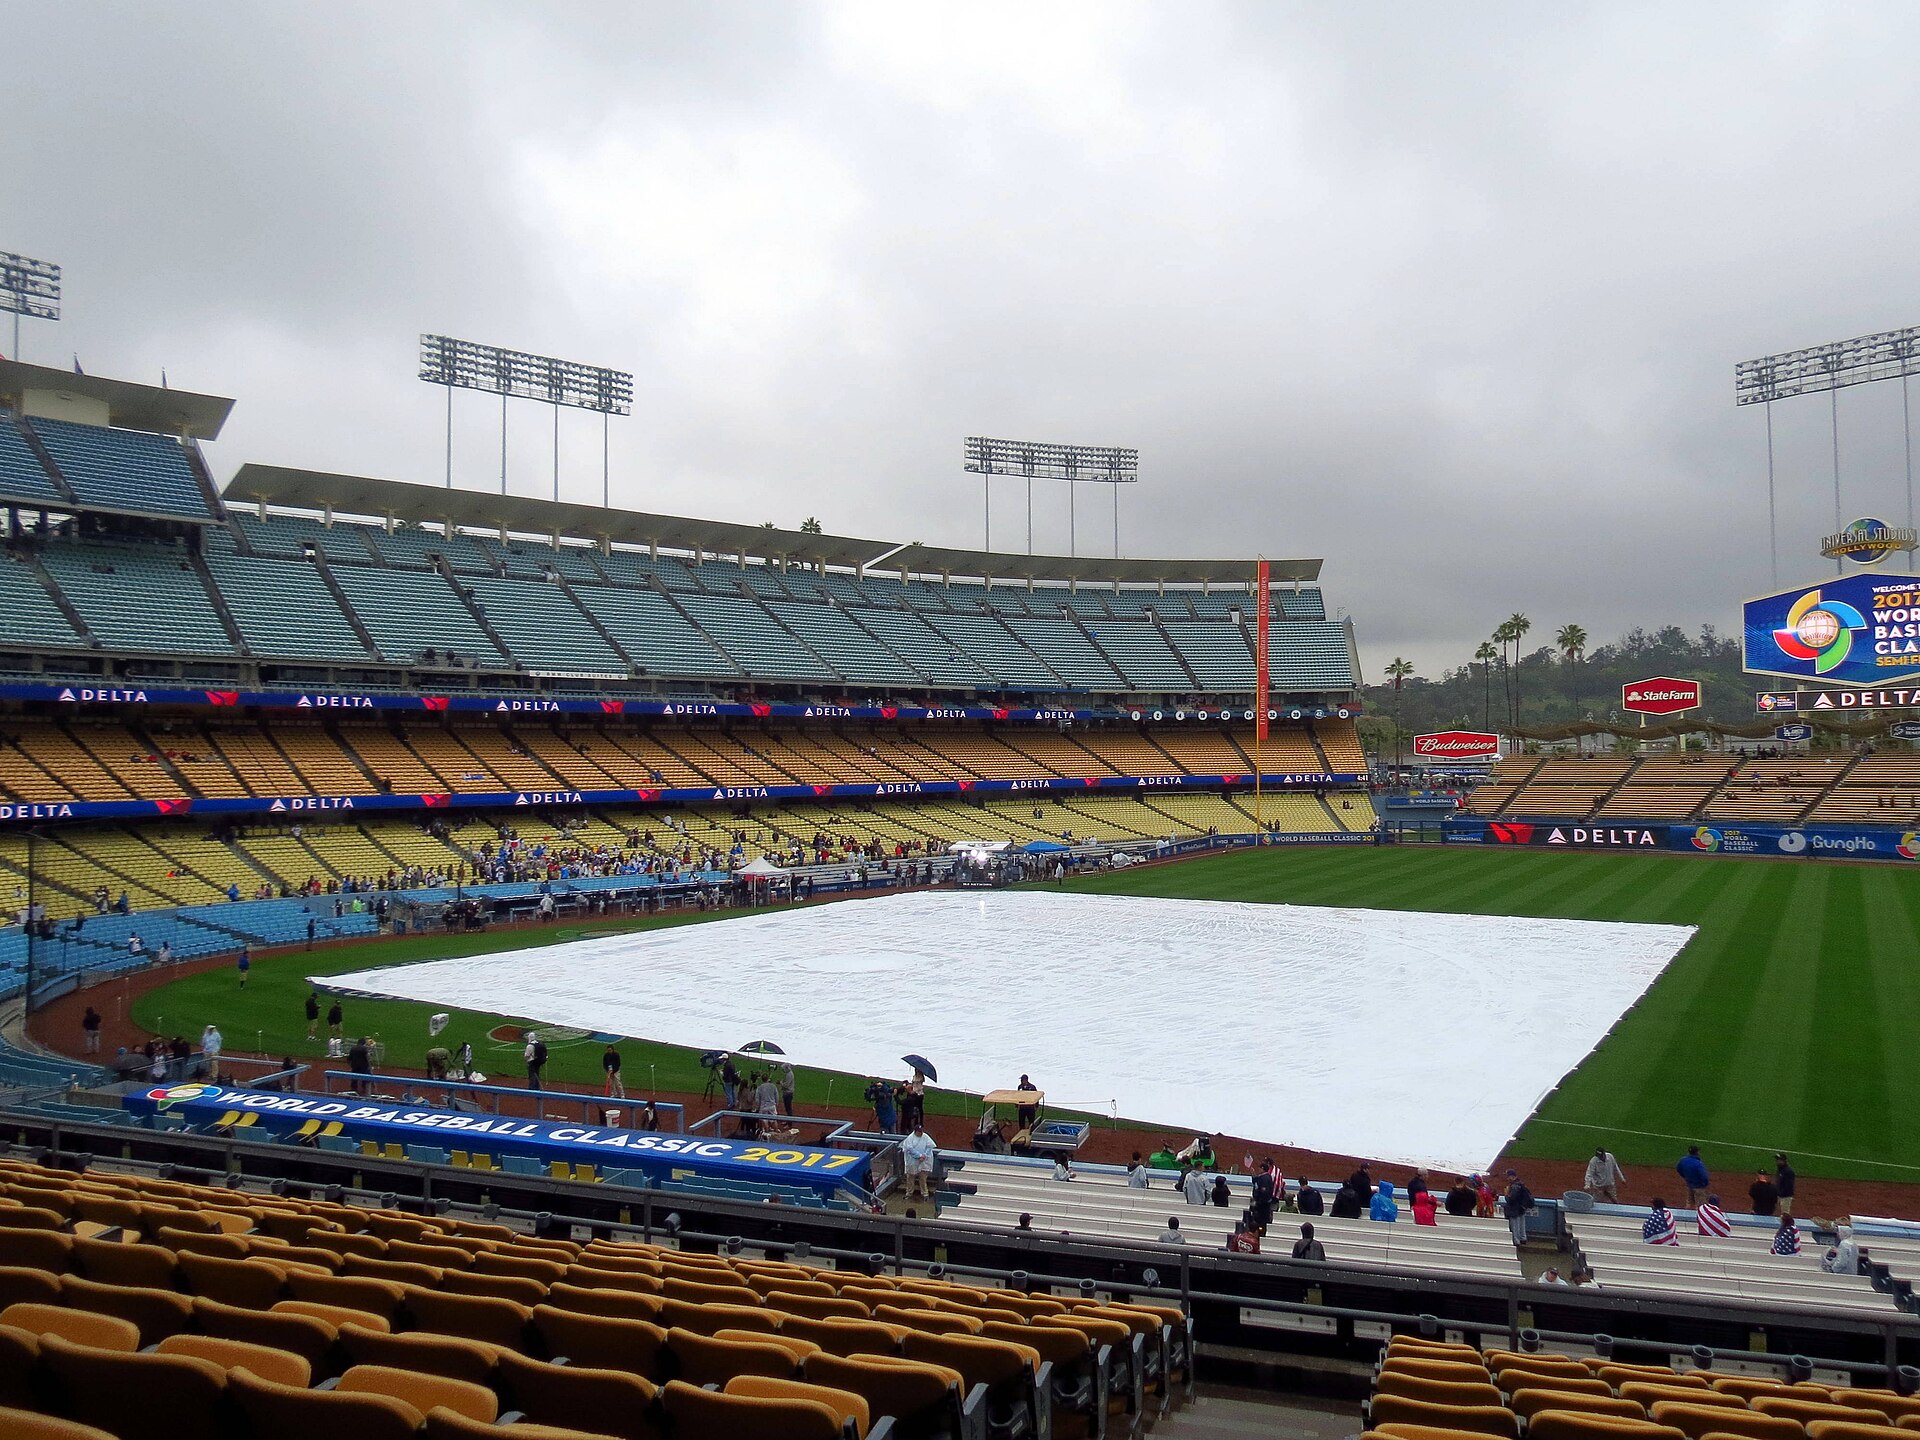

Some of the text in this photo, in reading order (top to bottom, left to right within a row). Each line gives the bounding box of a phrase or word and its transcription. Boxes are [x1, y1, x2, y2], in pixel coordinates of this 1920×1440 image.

[1820, 527, 1914, 550] UNIVERSAL STUDIOS
[1832, 542, 1902, 556] HOLLYWOOD
[1872, 584, 1916, 593] WELCOME
[1873, 591, 1920, 608] 2017
[1874, 640, 1920, 654] CLA
[1876, 655, 1920, 666] SEMI-F
[81, 690, 148, 702] DELTA
[317, 696, 373, 708] DELTA
[1840, 690, 1920, 706] DELTA
[512, 701, 560, 712] DELTA
[676, 705, 717, 715] DELTA
[816, 707, 851, 717] DELTA
[936, 709, 966, 719] DELTA
[1044, 709, 1075, 719] DELTA
[1418, 738, 1496, 752] Budweiser
[1020, 779, 1051, 788] DELTA
[1148, 776, 1182, 785] DELTA
[1295, 774, 1333, 782] DELTA
[728, 788, 768, 799] DELTA
[887, 784, 922, 793] DELTA
[291, 797, 354, 810] DELTA
[532, 793, 583, 805] DELTA
[0, 804, 73, 819] DELTA
[1573, 829, 1655, 845] DELTA
[1813, 835, 1876, 852] GungHo
[216, 1090, 863, 1171] WORLD BASEBALL CLASSIC 2017
